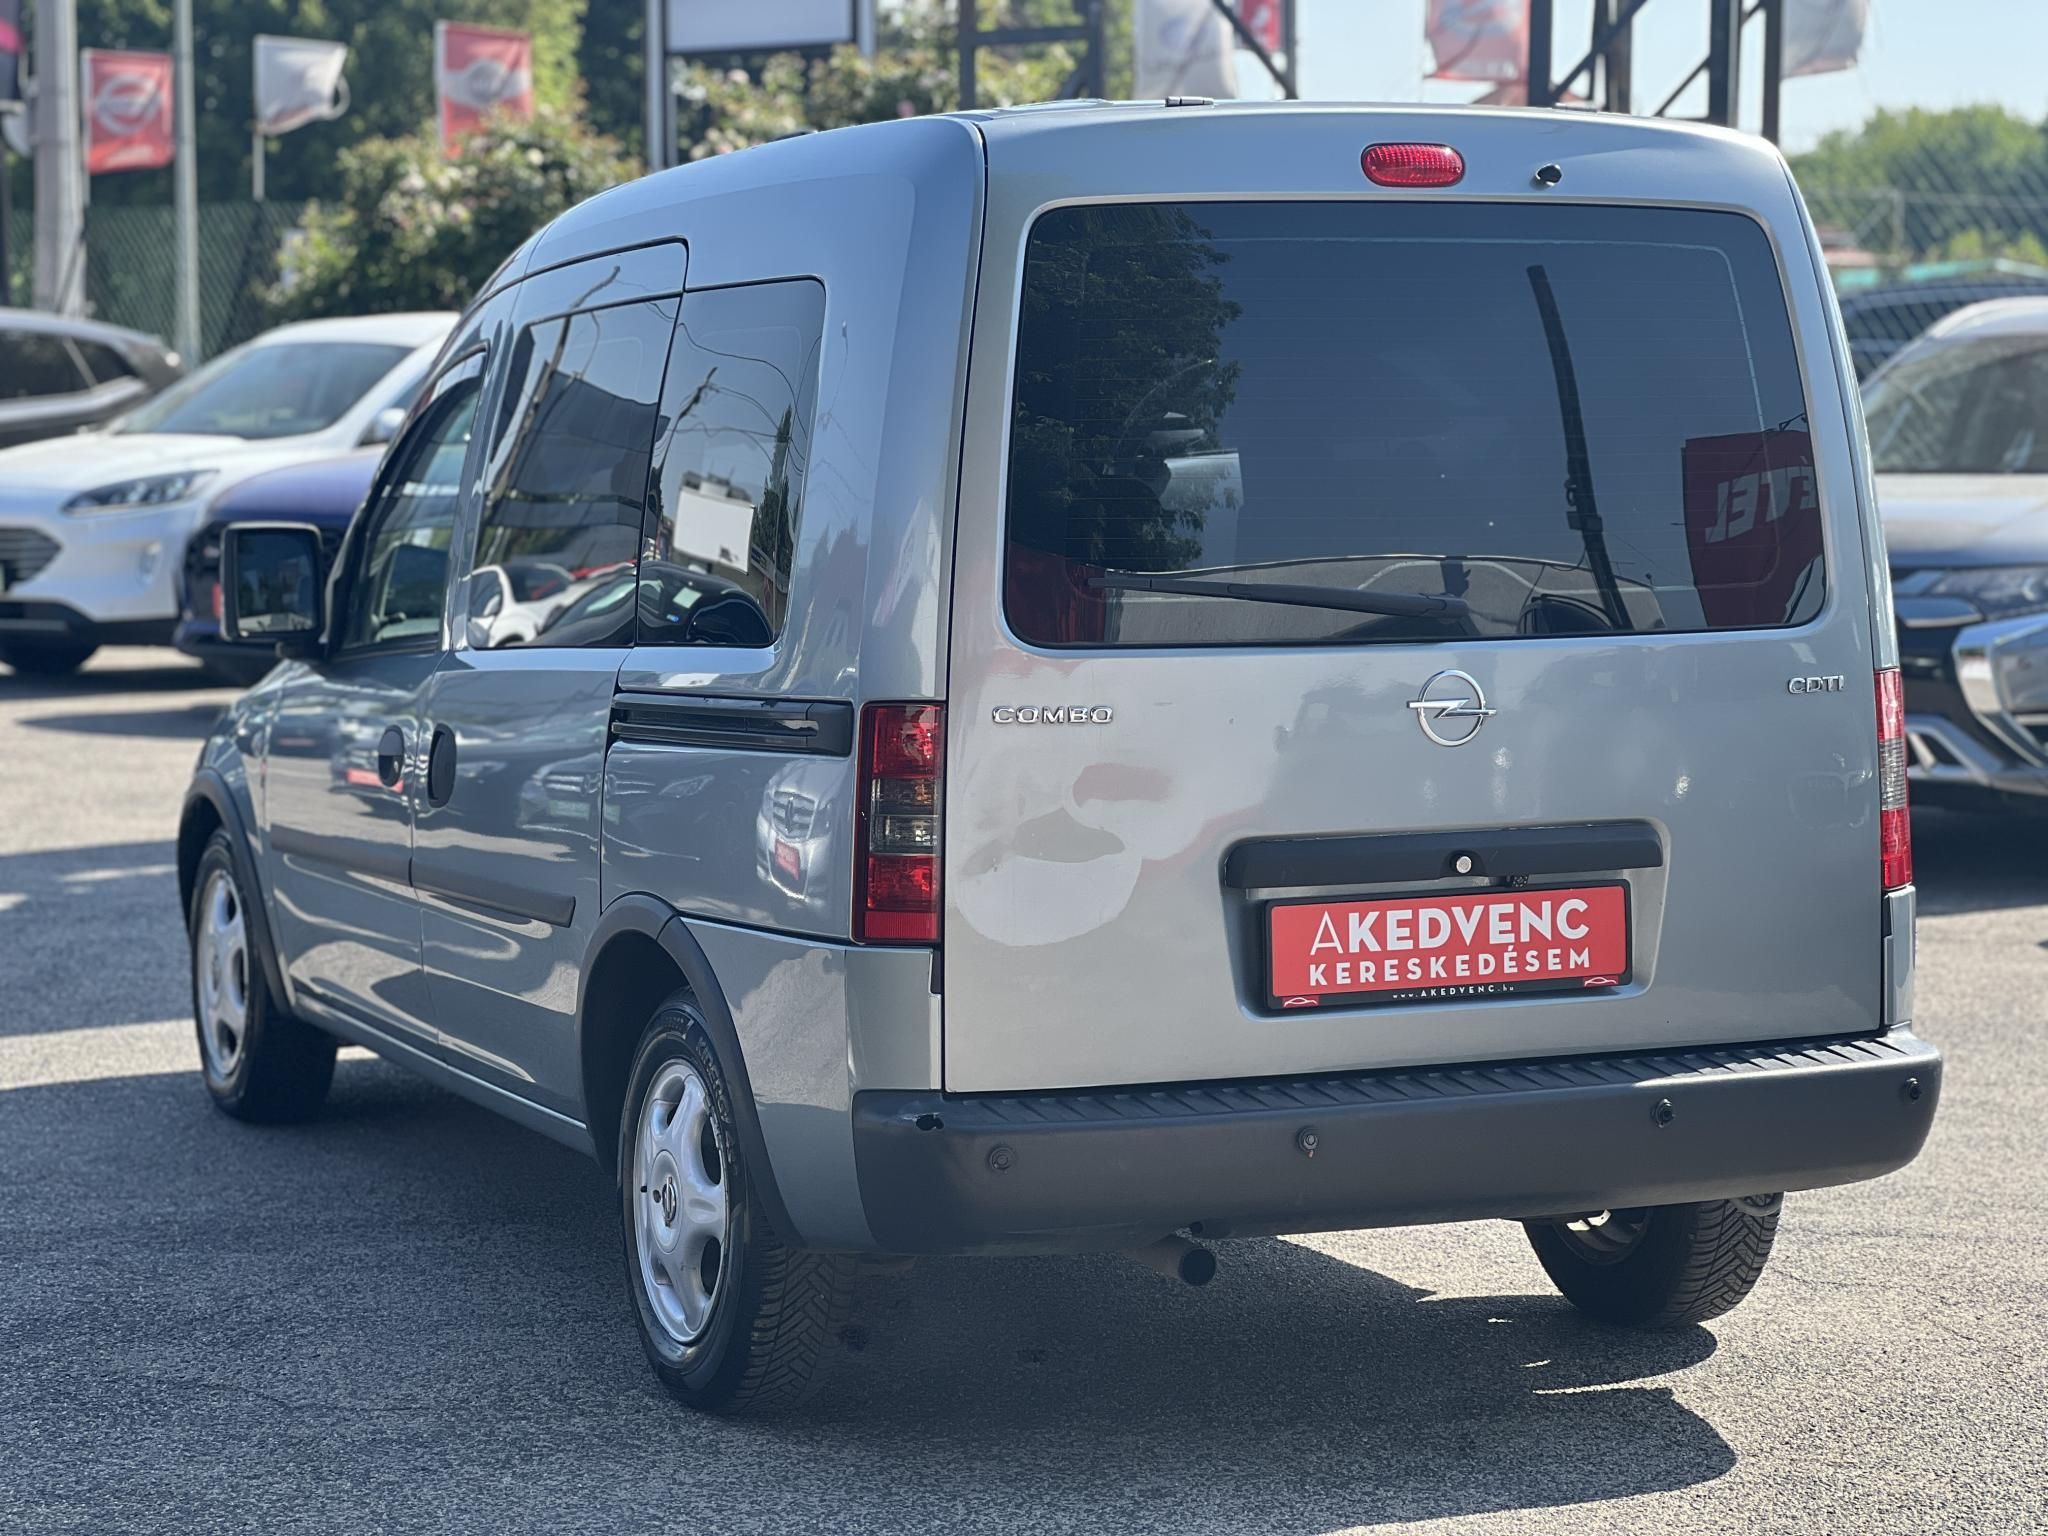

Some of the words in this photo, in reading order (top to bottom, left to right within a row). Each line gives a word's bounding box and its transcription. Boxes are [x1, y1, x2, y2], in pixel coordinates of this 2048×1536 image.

[1788, 675, 1844, 694] CDTI
[992, 705, 1113, 724] COMBO
[1309, 898, 1590, 956] AKEDVENC
[1309, 944, 1591, 987] KERESKEDÉSEM
[1392, 984, 1514, 999] www.AKEDVENC.hu
